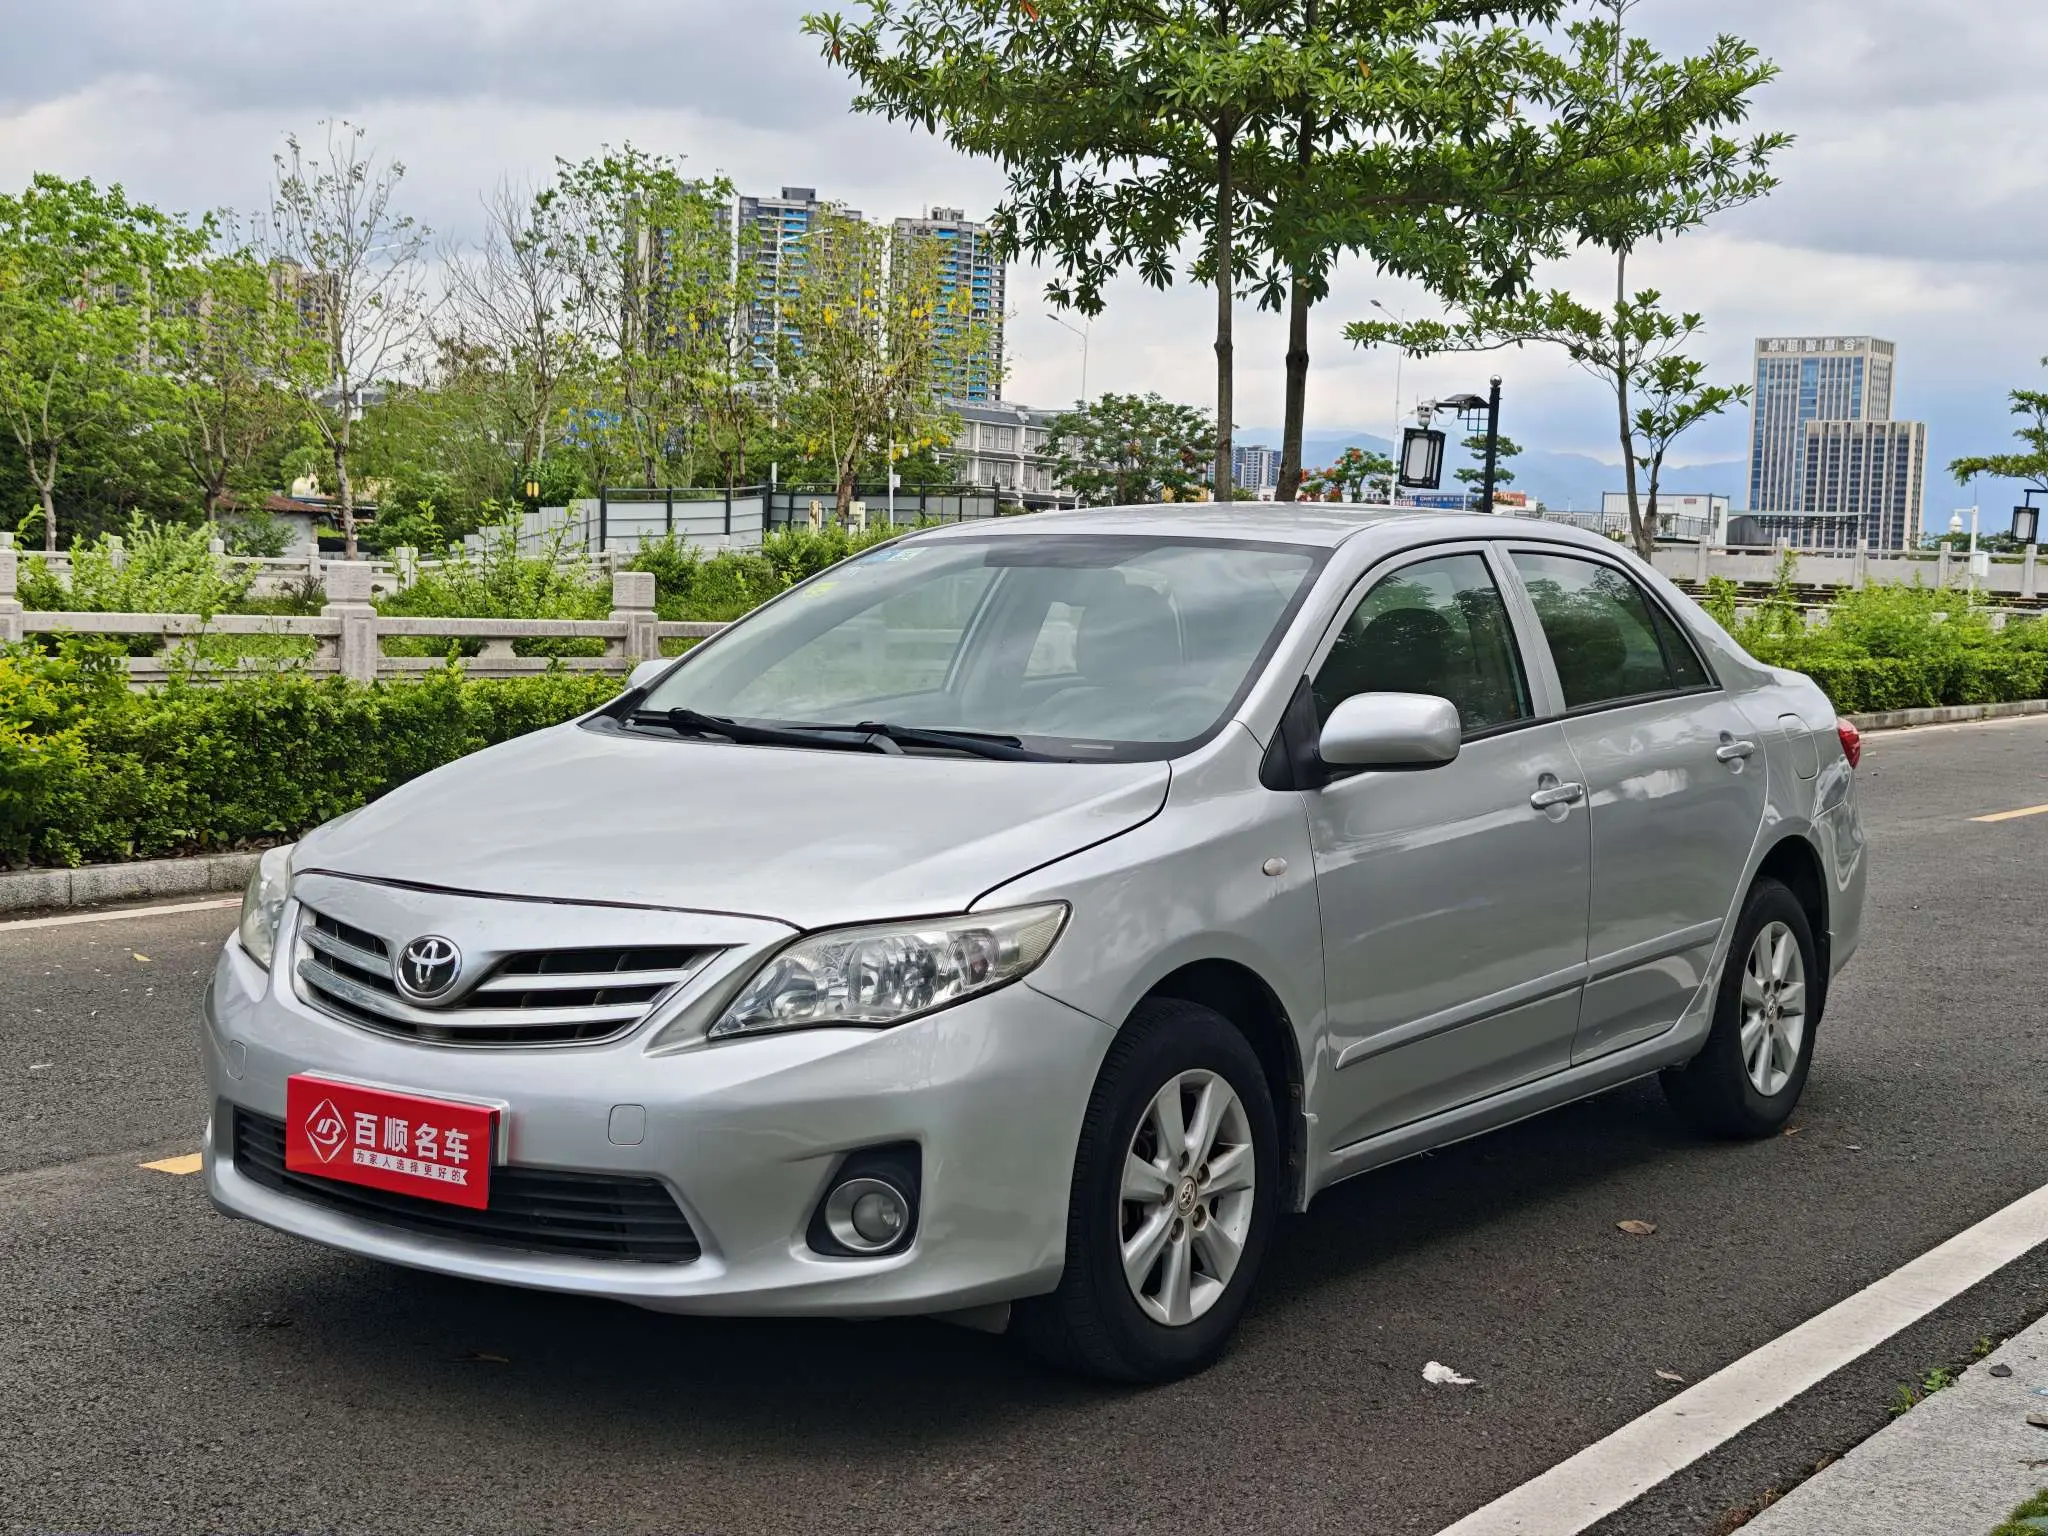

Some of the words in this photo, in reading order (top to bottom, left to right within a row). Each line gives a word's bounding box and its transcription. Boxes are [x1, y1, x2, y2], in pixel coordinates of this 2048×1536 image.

[353, 1111, 470, 1165] 百顺名车
[356, 1150, 461, 1182] 为家人选择更好的
